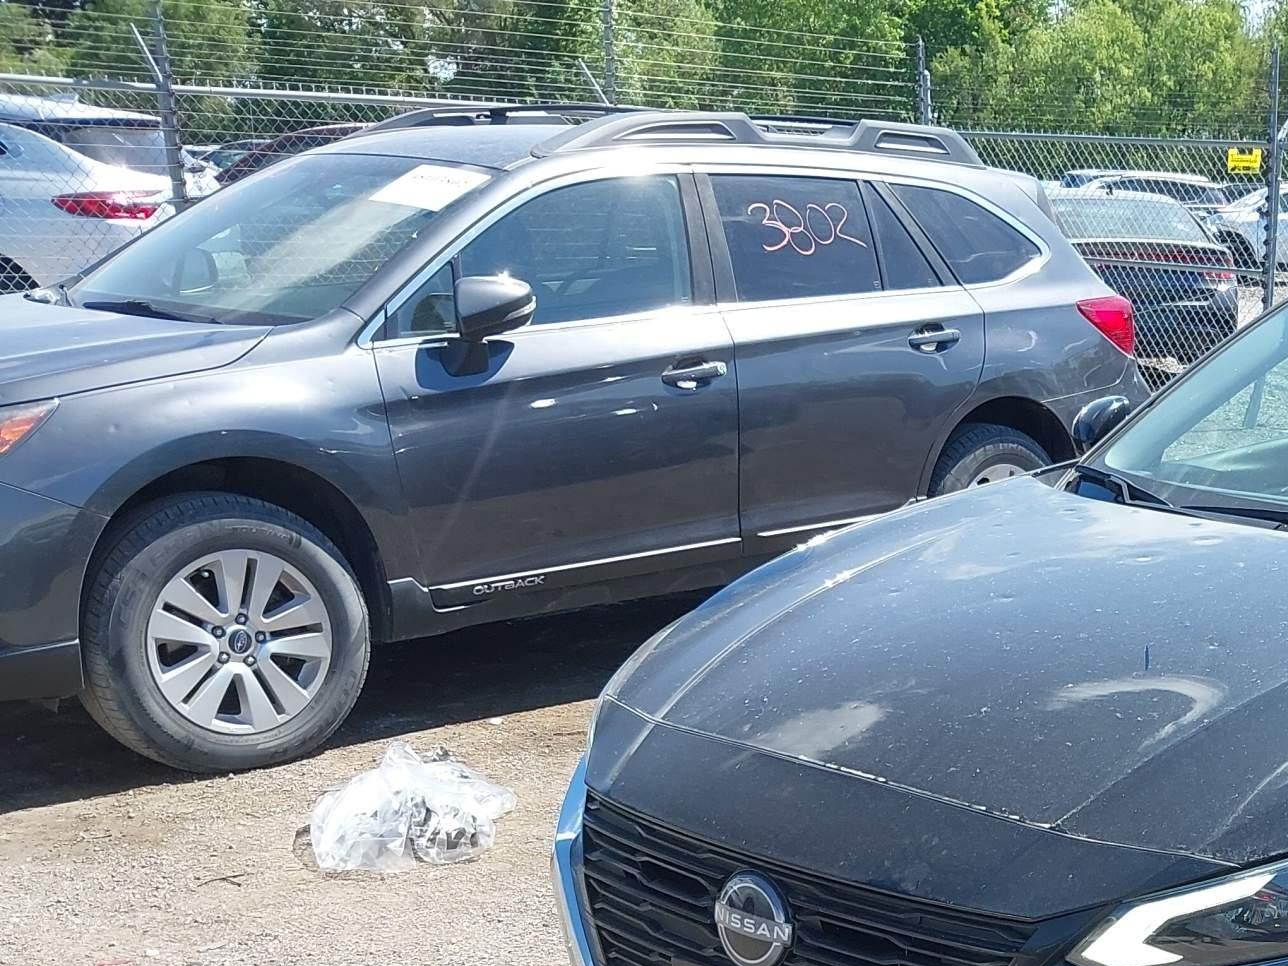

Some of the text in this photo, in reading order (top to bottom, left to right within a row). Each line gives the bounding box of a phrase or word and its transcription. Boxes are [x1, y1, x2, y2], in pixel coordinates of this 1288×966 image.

[747, 199, 868, 256] 3802
[472, 575, 545, 596] OUTBACK
[716, 907, 789, 941] NISSAN
